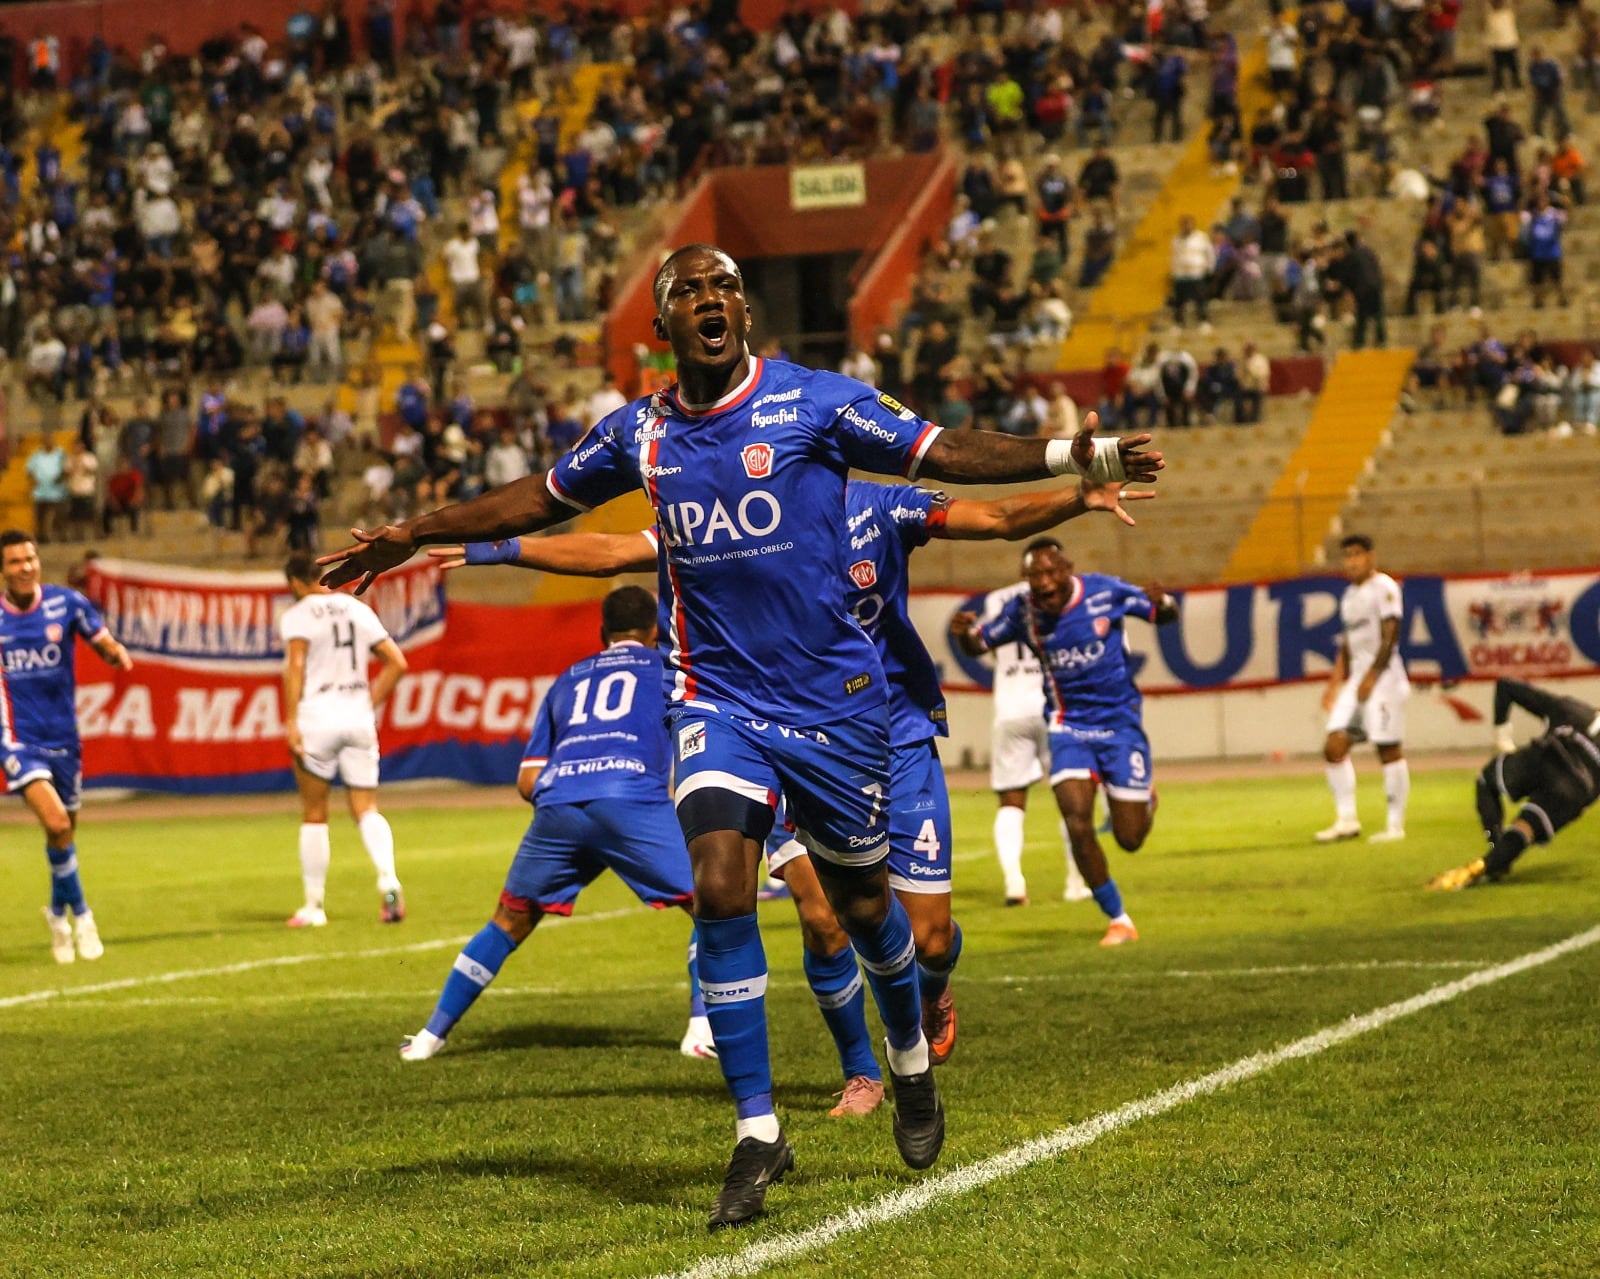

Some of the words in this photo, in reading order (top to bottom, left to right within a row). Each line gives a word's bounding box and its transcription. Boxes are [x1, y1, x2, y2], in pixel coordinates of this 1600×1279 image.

[751, 406, 798, 429] Aguafiel
[579, 427, 616, 463] Blenod
[634, 422, 668, 445] Aguafiel
[663, 489, 782, 548] UPAO
[692, 554, 721, 565] PRIVADA
[722, 548, 760, 560] ANTENOR
[760, 541, 794, 555] ORREGO
[332, 620, 357, 671] 4
[1051, 640, 1105, 668] PAO
[1469, 640, 1572, 668] CHICAGO
[568, 670, 638, 726] 10
[558, 763, 576, 778] EL
[577, 758, 647, 776] MILAGRO
[1129, 750, 1146, 778] 9
[861, 782, 883, 829] 7
[913, 818, 941, 862] 4
